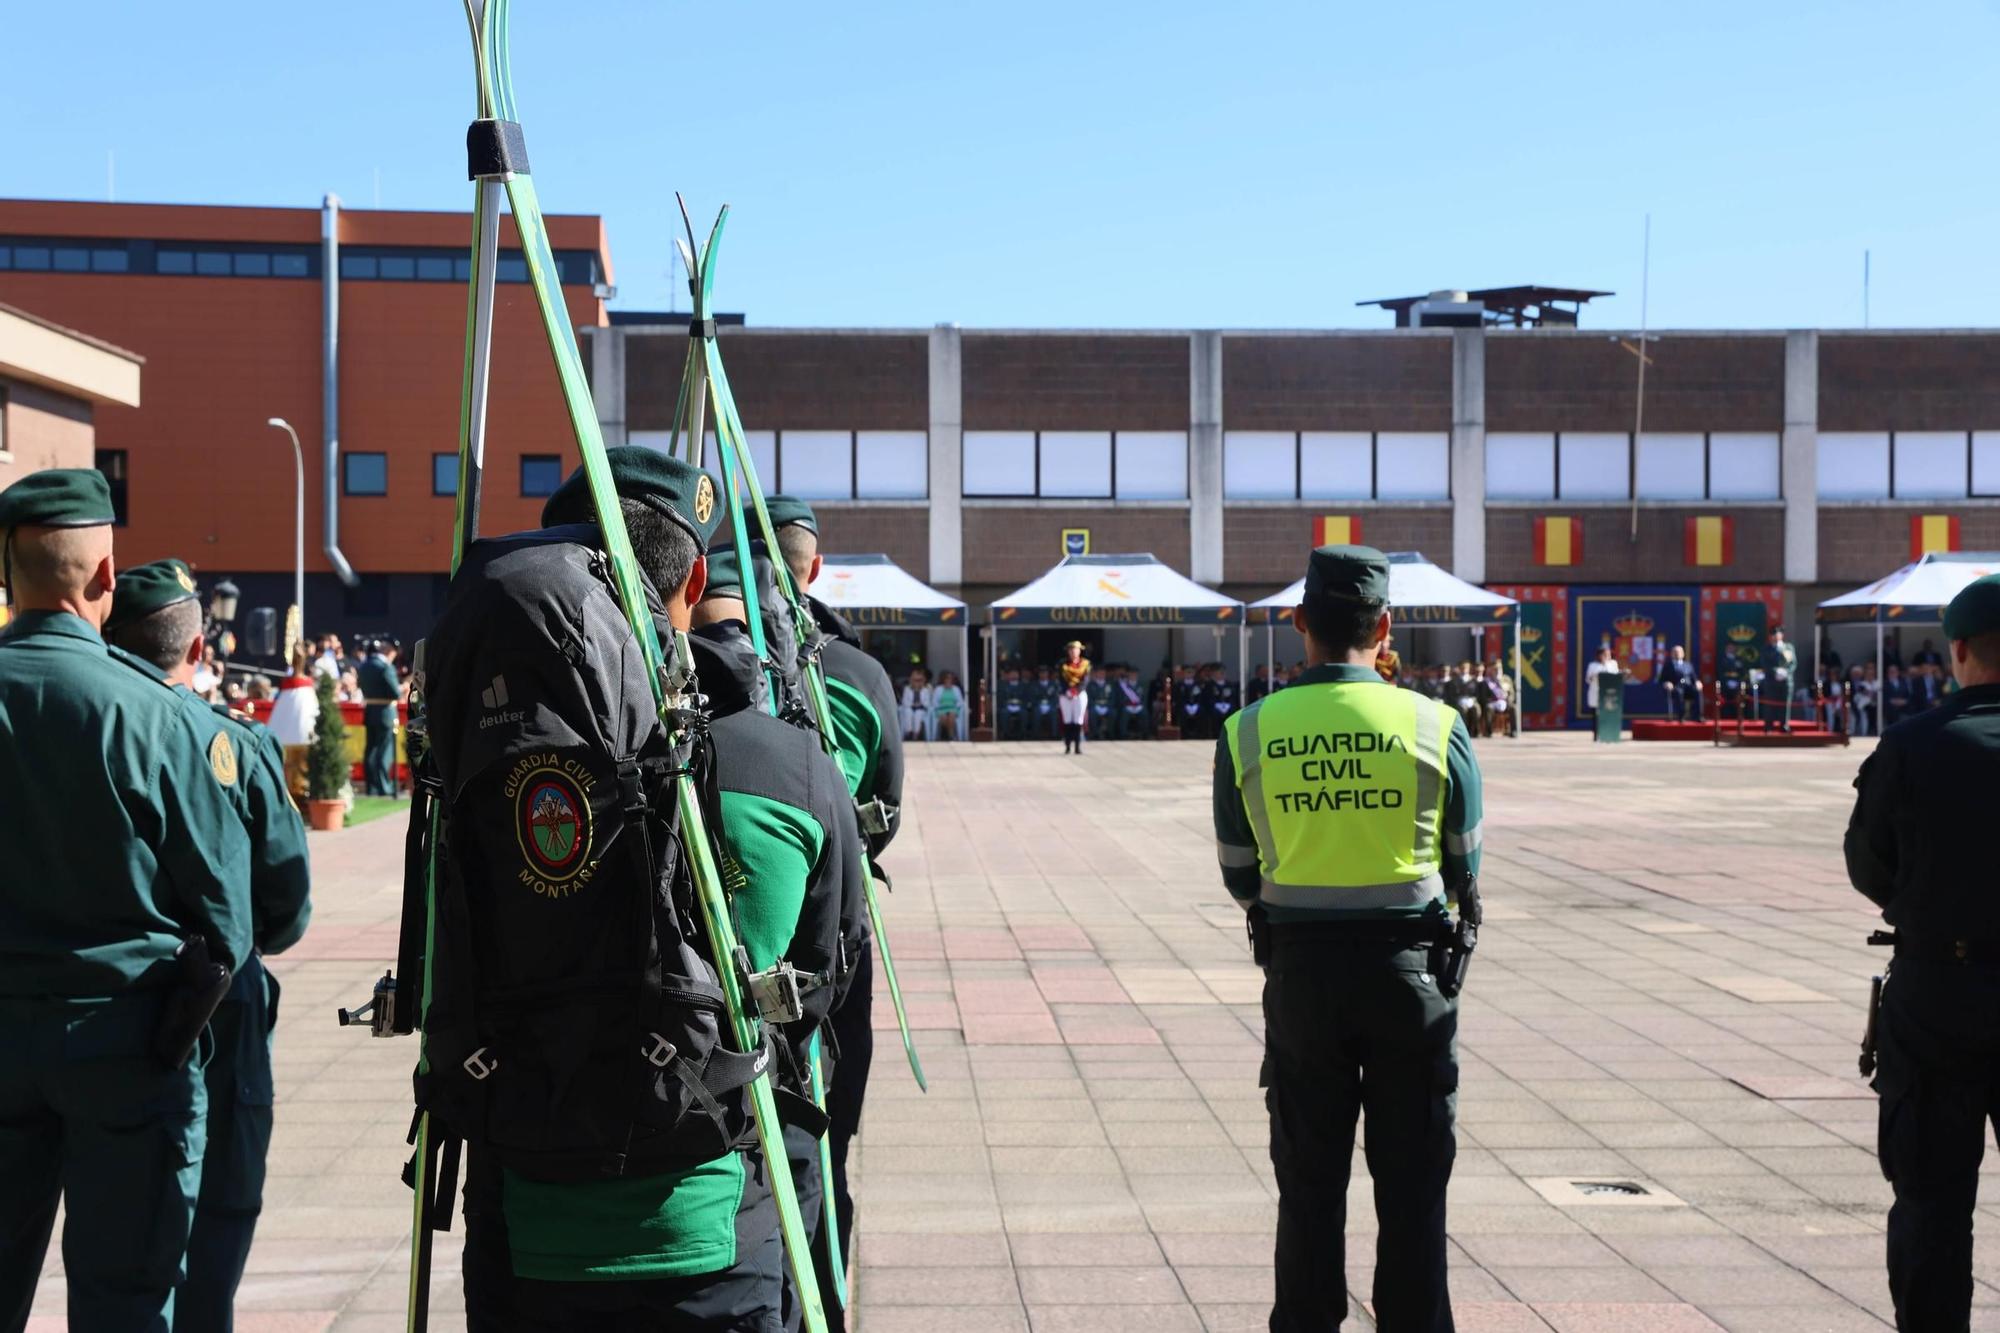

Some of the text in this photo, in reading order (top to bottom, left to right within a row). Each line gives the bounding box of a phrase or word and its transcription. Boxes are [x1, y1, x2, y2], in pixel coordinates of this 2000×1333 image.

[858, 607, 907, 623] CIVIL
[1051, 606, 1184, 622] GUARDIA CIVIL
[1412, 605, 1460, 621] CIVIL
[480, 711, 525, 729] deuter
[1267, 732, 1407, 759] GUARDIA
[504, 753, 597, 798] GUARDIA CIVIL
[1302, 759, 1372, 781] CIVIL
[1274, 786, 1403, 813] TRÁFICO
